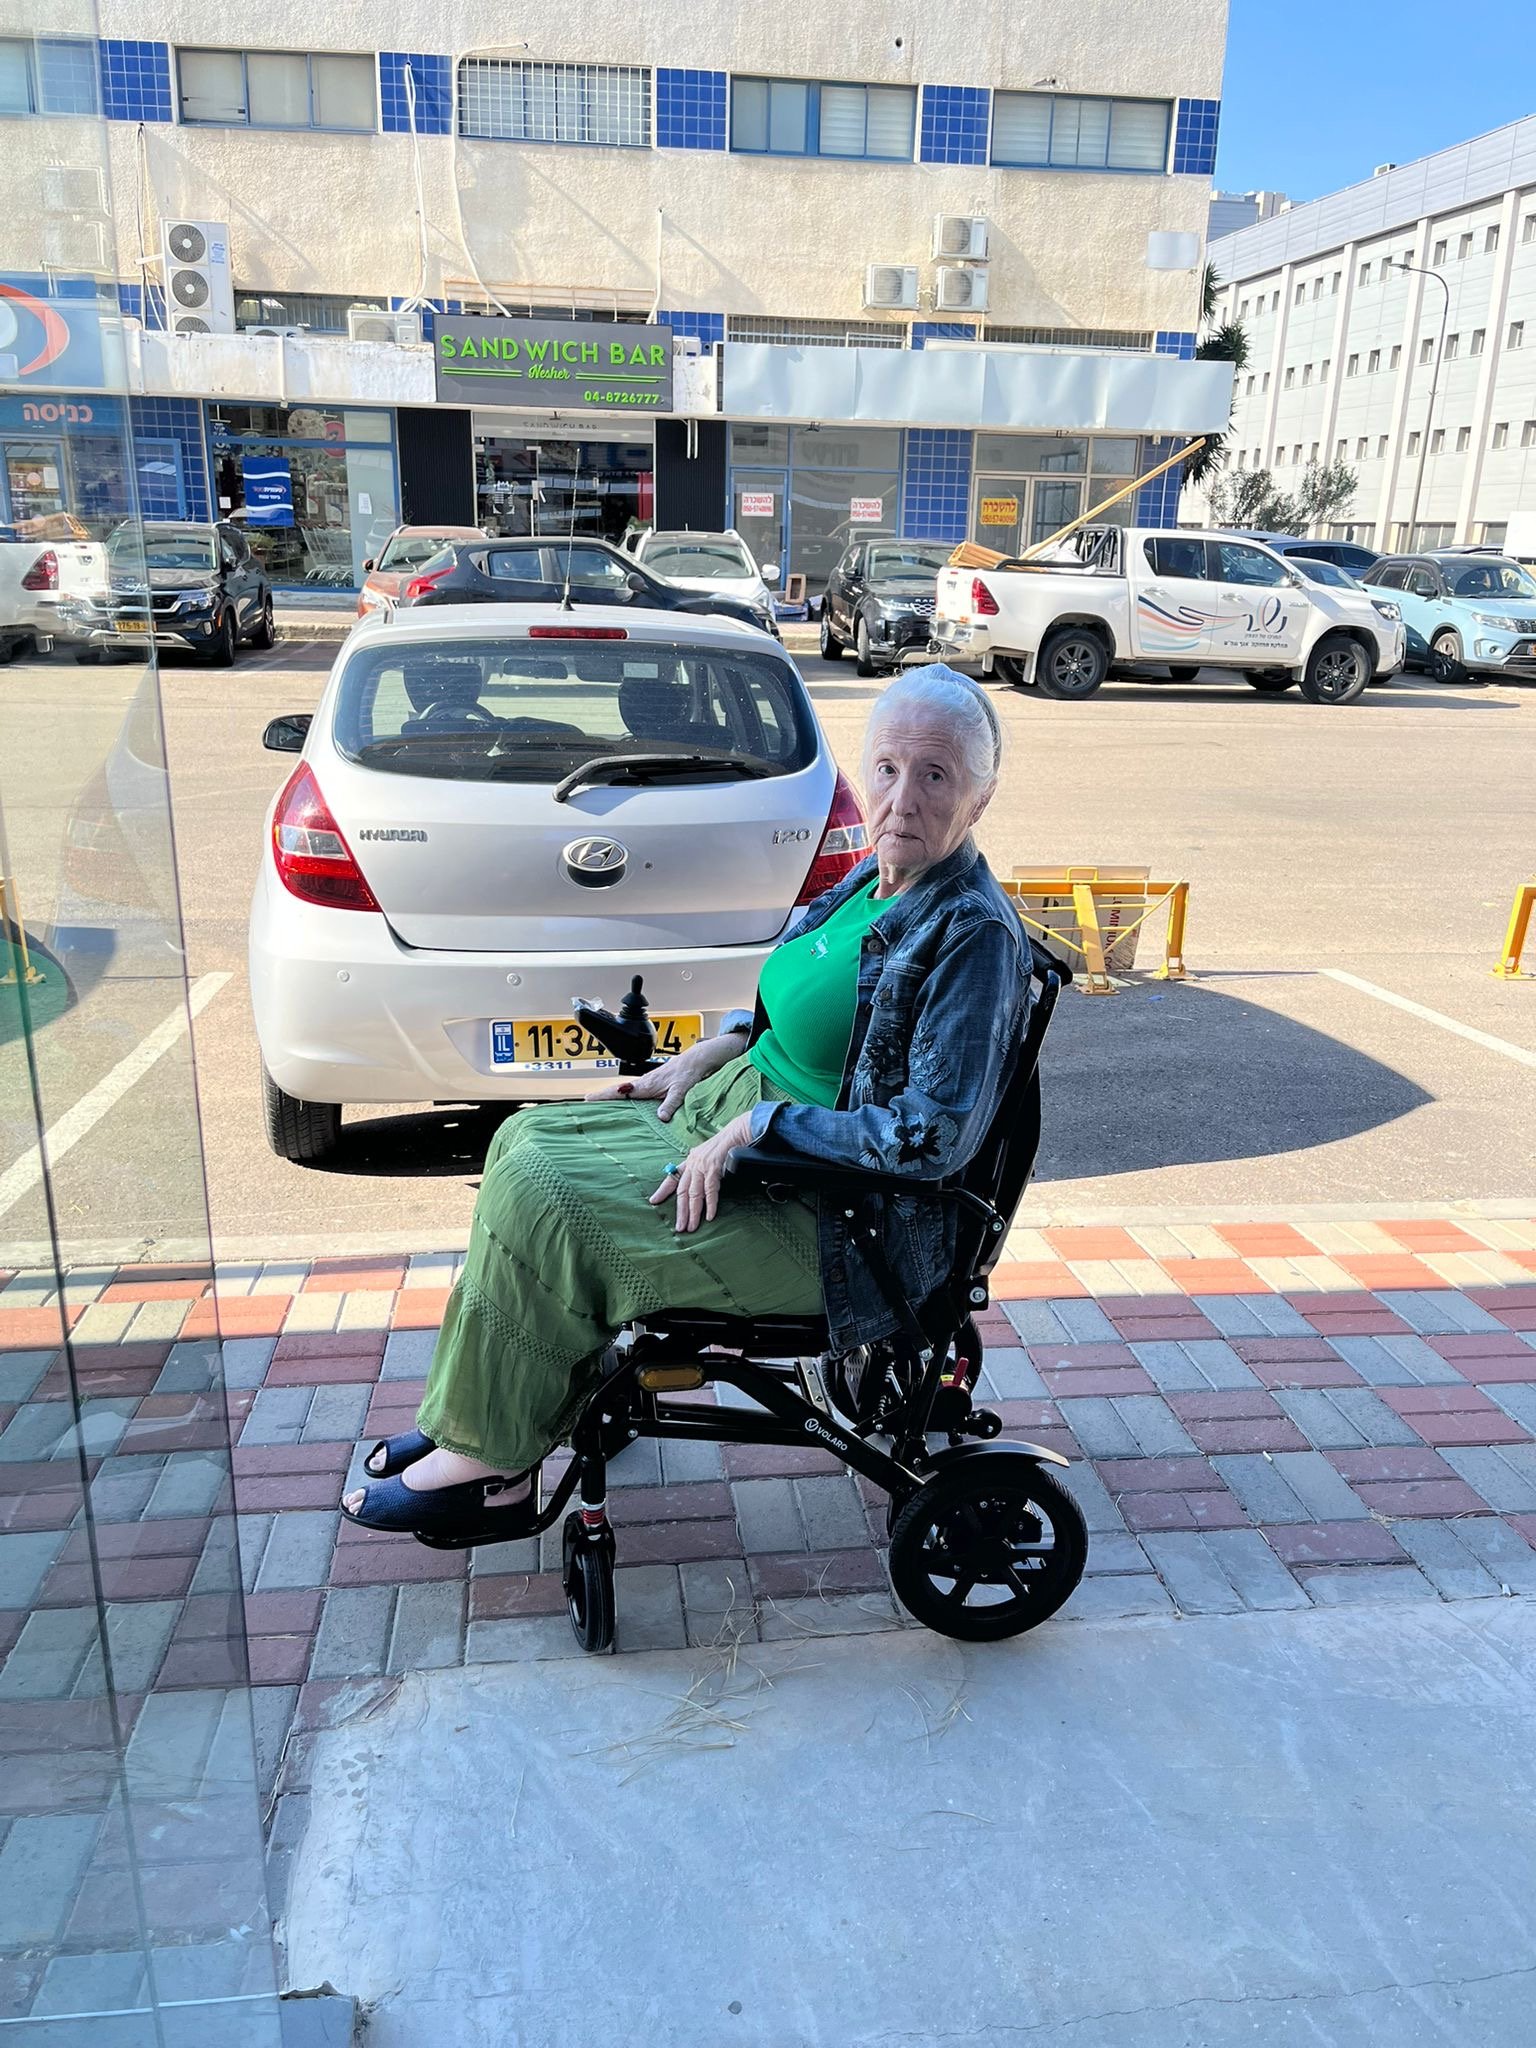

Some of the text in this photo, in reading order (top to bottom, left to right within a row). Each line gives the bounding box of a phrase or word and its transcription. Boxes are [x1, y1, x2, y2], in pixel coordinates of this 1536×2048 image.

[440, 334, 666, 367] SANDWICH BAR
[528, 364, 571, 380] Nesher
[583, 390, 660, 404] 04-8726777
[22, 402, 93, 423] כניסה
[983, 500, 1016, 512] להשכרה
[359, 829, 428, 842] HYUNDAI
[772, 828, 811, 845] i20
[497, 1035, 510, 1051] IL
[817, 1426, 848, 1451] VOLARO
